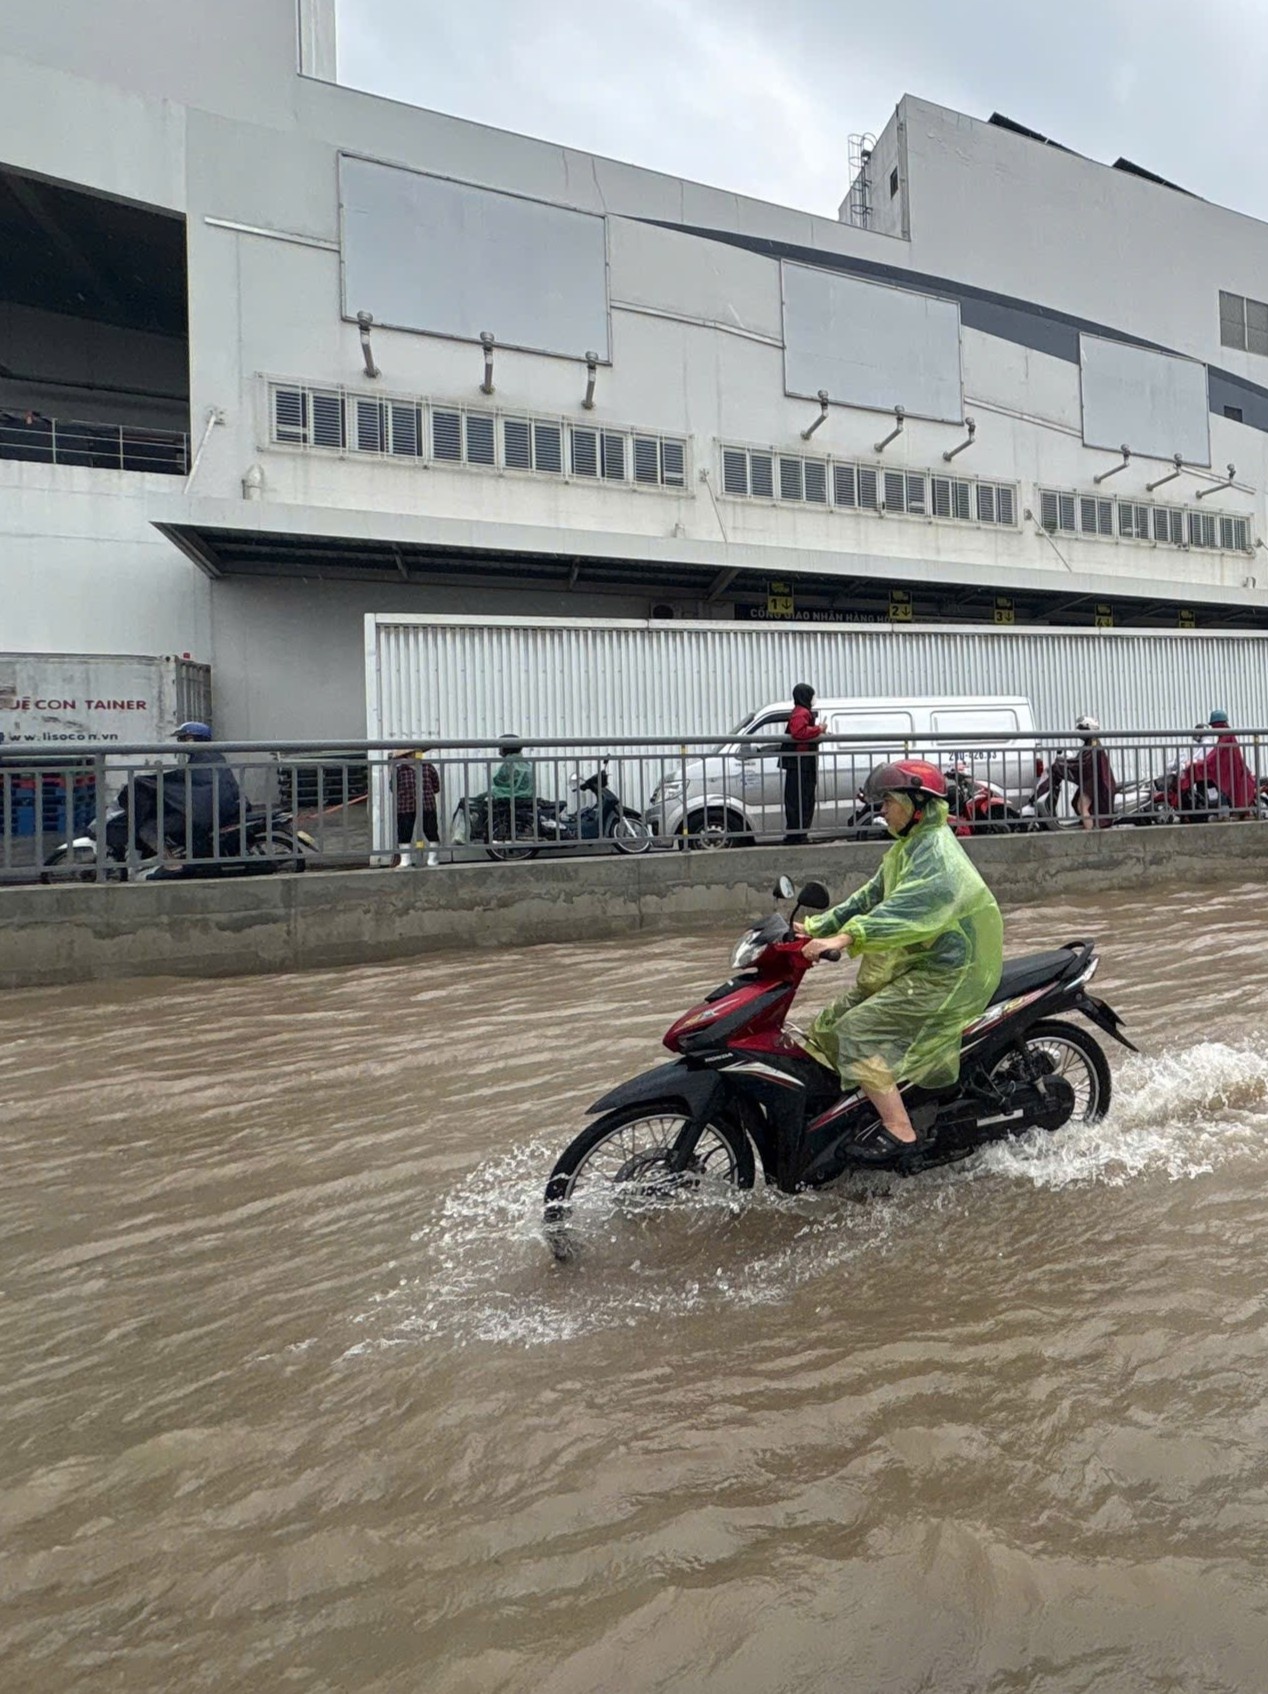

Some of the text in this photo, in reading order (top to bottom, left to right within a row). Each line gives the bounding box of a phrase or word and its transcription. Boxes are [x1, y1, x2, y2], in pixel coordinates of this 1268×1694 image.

[771, 599, 778, 609] 1
[892, 606, 899, 616] 2
[996, 611, 1003, 621] 3
[35, 699, 76, 710] CON
[85, 699, 147, 710] TAINER
